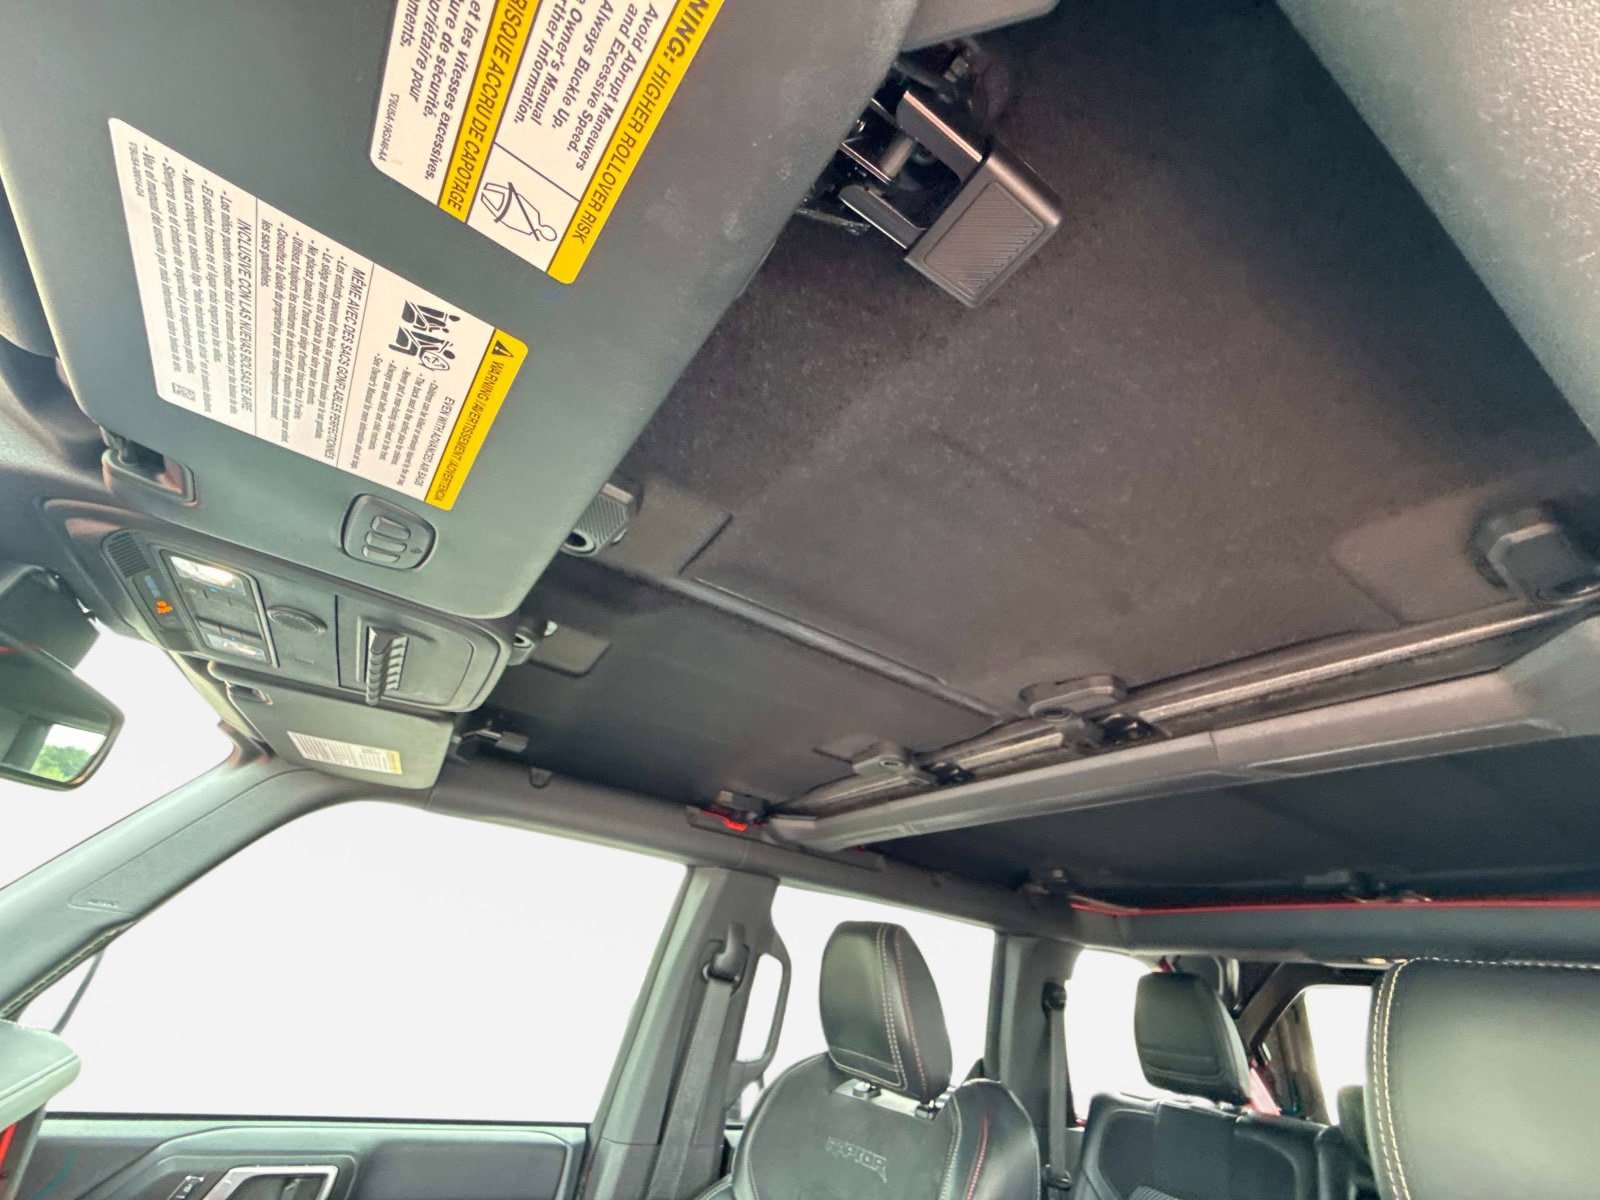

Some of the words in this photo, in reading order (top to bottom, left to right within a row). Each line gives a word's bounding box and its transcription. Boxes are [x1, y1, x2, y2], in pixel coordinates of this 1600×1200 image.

[468, 0, 481, 21] et
[619, 3, 638, 39] and
[461, 21, 478, 48] les
[551, 8, 582, 71] Owner's
[583, 0, 613, 56] Always
[631, 3, 658, 53] Avoid
[439, 32, 454, 54] de
[409, 68, 424, 102] pour
[423, 55, 447, 117] sécurité.
[444, 50, 468, 110] vitesses
[514, 40, 554, 123] Information.
[562, 56, 590, 106] Buckle
[587, 37, 625, 108] Excessive
[607, 50, 637, 102] Abrupt
[476, 58, 505, 120] ACCRU
[531, 72, 558, 125] Manual
[628, 64, 671, 133] HIGHER
[468, 116, 488, 143] DE
[552, 108, 570, 128] Up.
[567, 110, 593, 152] Speed.
[425, 112, 450, 179] excessives.
[576, 102, 614, 171] Maneuvers
[142, 152, 156, 171] Vea
[447, 140, 480, 211] CAPOTAGE
[588, 132, 636, 212] ROLLOVER
[144, 170, 158, 182] el
[162, 163, 176, 200] Siempre
[182, 174, 195, 203] Nunca
[201, 184, 214, 197] El
[220, 195, 232, 213] Los
[166, 199, 178, 217] use
[168, 216, 181, 228] el
[202, 195, 215, 226] asiento
[204, 226, 215, 254] trasero
[261, 219, 273, 233] les
[572, 210, 597, 244] RISK
[237, 218, 252, 279] INCLUSIVE
[261, 232, 270, 251] sacs
[276, 228, 288, 265] Consultez
[291, 236, 304, 265] Utilisez
[307, 244, 319, 256] Ne
[275, 263, 286, 273] le
[305, 254, 317, 280] placez
[322, 252, 334, 264] Le
[336, 260, 348, 275] Les
[275, 272, 286, 292] Guide
[288, 264, 301, 293] toujours
[319, 262, 331, 283] siège
[349, 267, 366, 300] MÊME
[238, 278, 252, 302] CON
[289, 292, 299, 303] les
[317, 281, 328, 305] arrière
[332, 274, 344, 300] enfants
[239, 300, 252, 321] LAS
[316, 304, 326, 316] est
[345, 297, 360, 325] AVEC
[239, 319, 252, 354] NUEVAS
[342, 324, 356, 344] DES
[240, 353, 252, 385] BOLSAS
[338, 343, 352, 367] SACS
[241, 383, 252, 396] DE
[331, 366, 348, 413] GONFLABLES
[477, 361, 504, 401] WARNING
[241, 394, 252, 412] AIRE
[440, 396, 455, 416] EVEN
[434, 415, 448, 433] WITH
[423, 431, 441, 463] ADVANCED
[414, 471, 427, 487] BAGS
[419, 461, 430, 472] AIR
